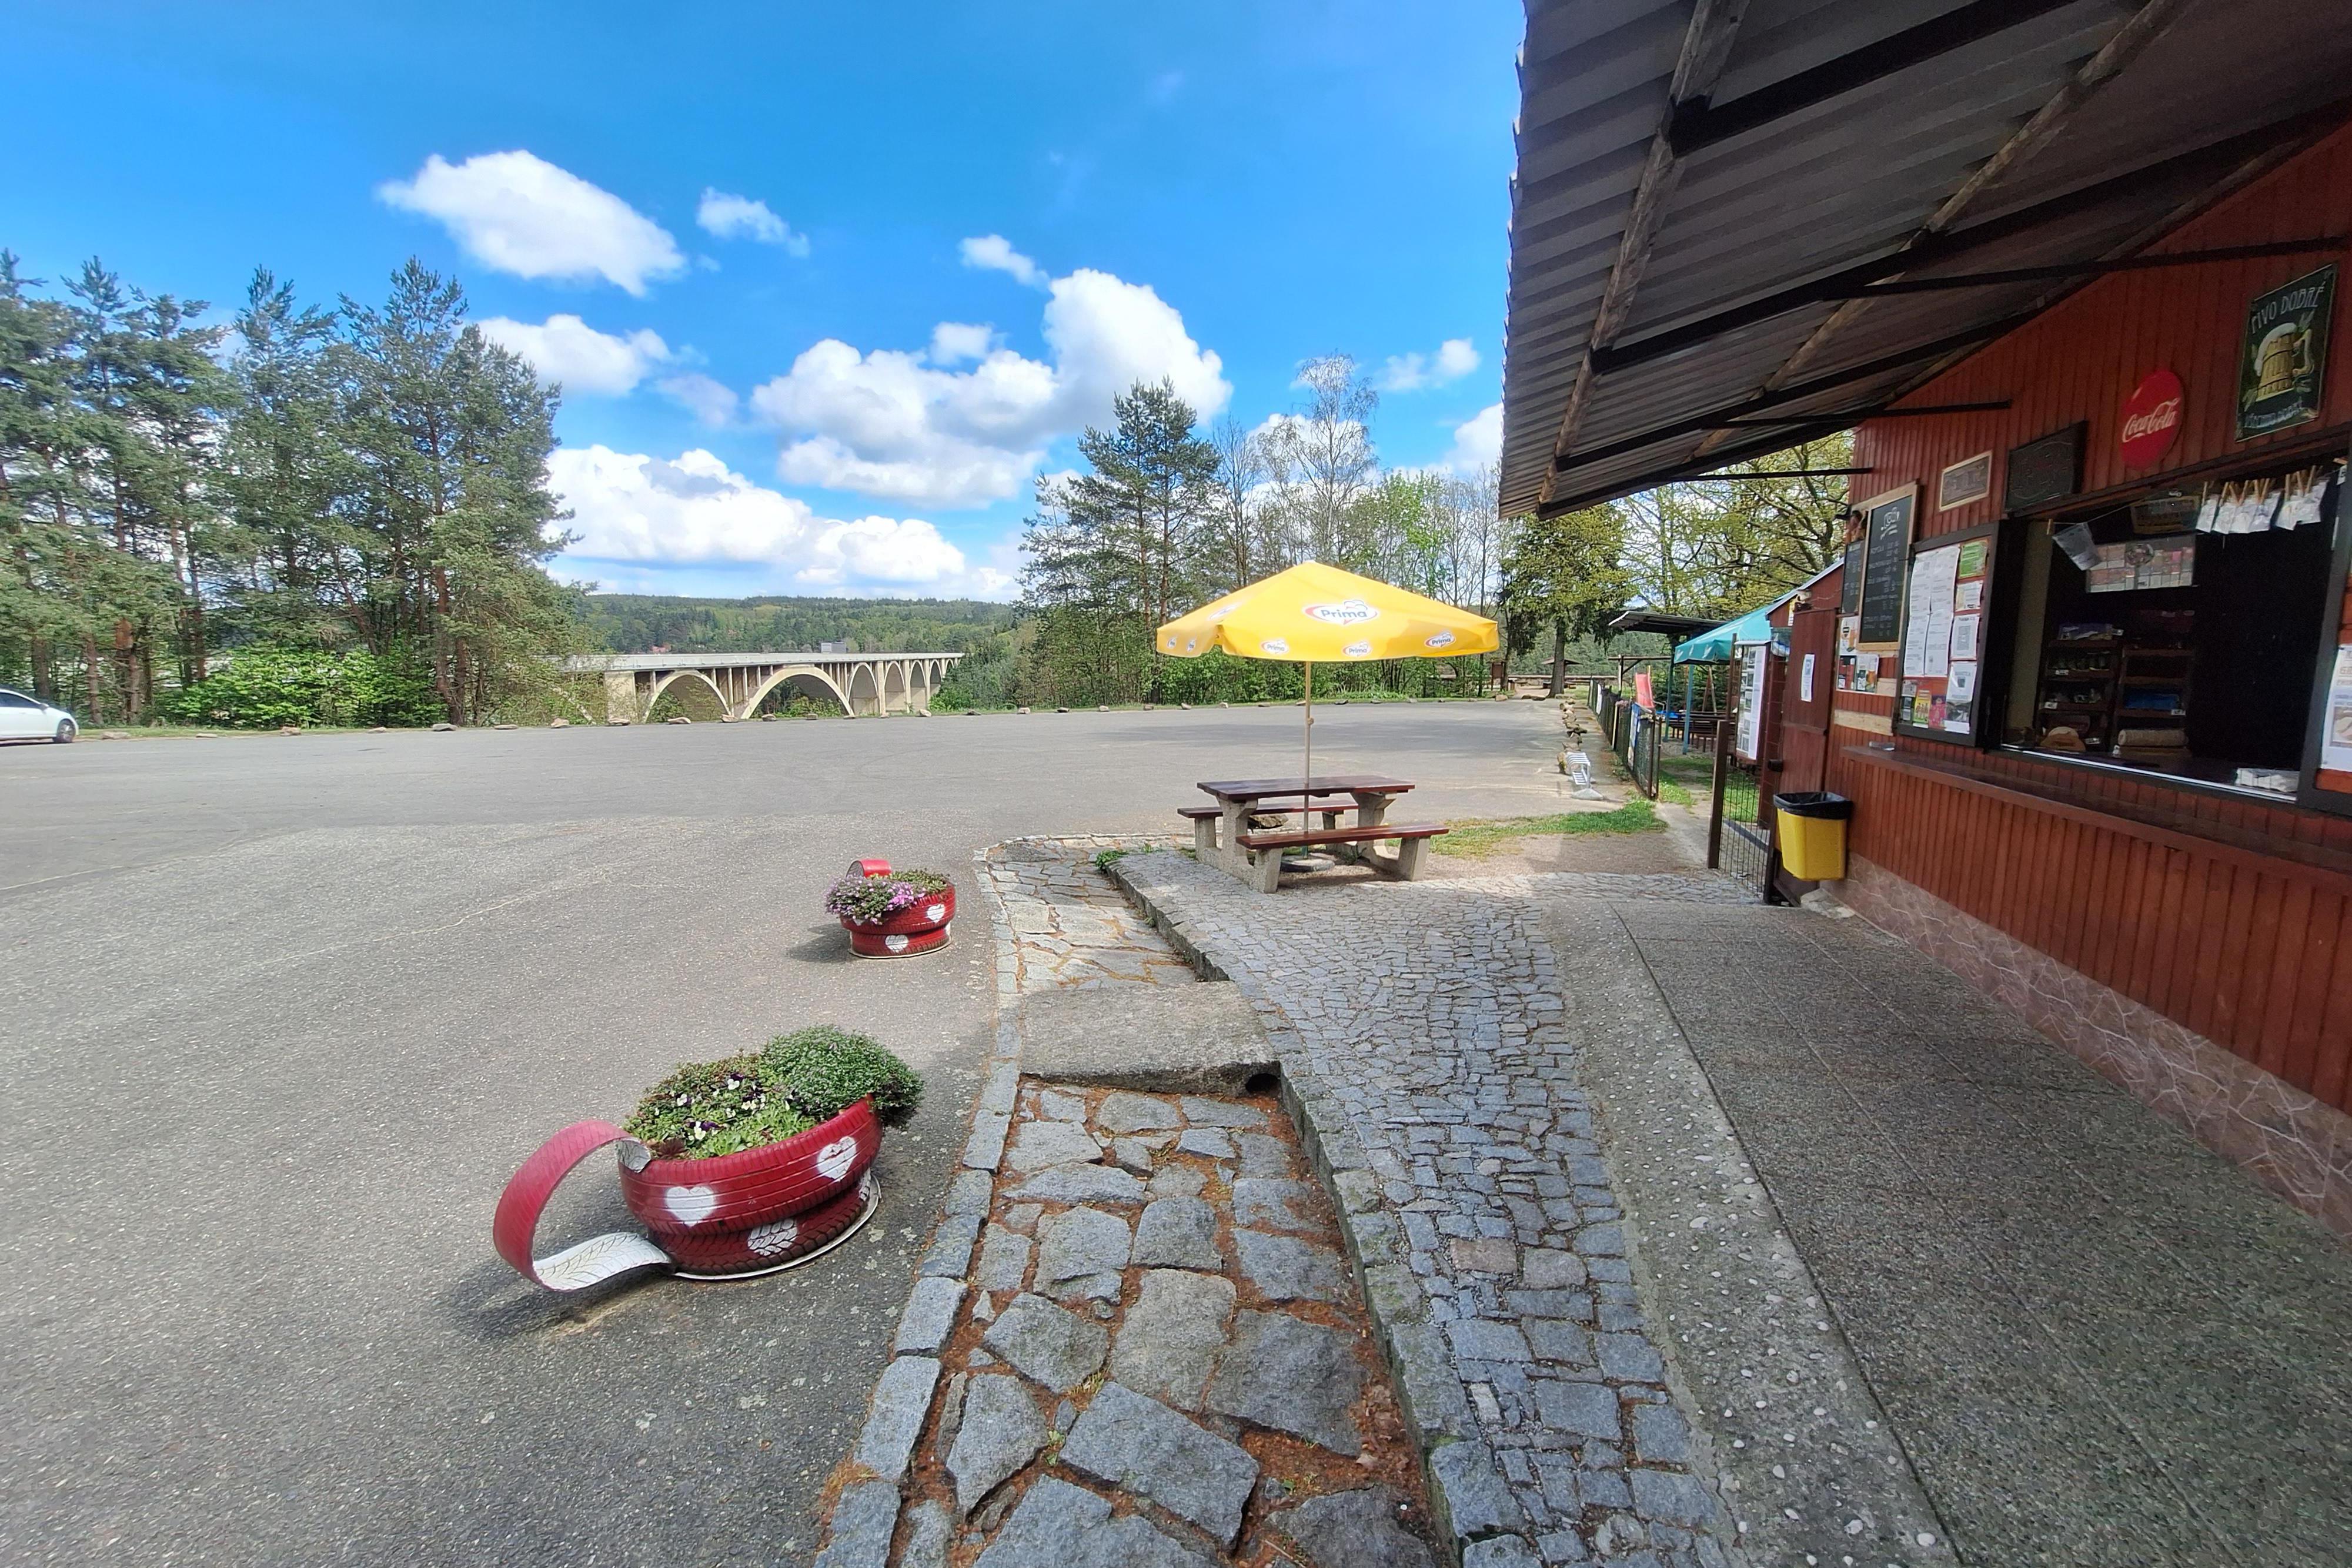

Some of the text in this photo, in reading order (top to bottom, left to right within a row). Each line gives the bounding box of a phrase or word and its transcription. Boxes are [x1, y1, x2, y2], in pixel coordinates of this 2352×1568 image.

[2280, 281, 2326, 315] DOBRÉ
[2122, 397, 2181, 443] Coca-Cola
[1321, 609, 1367, 618] Prima
[1432, 636, 1451, 645] Prima
